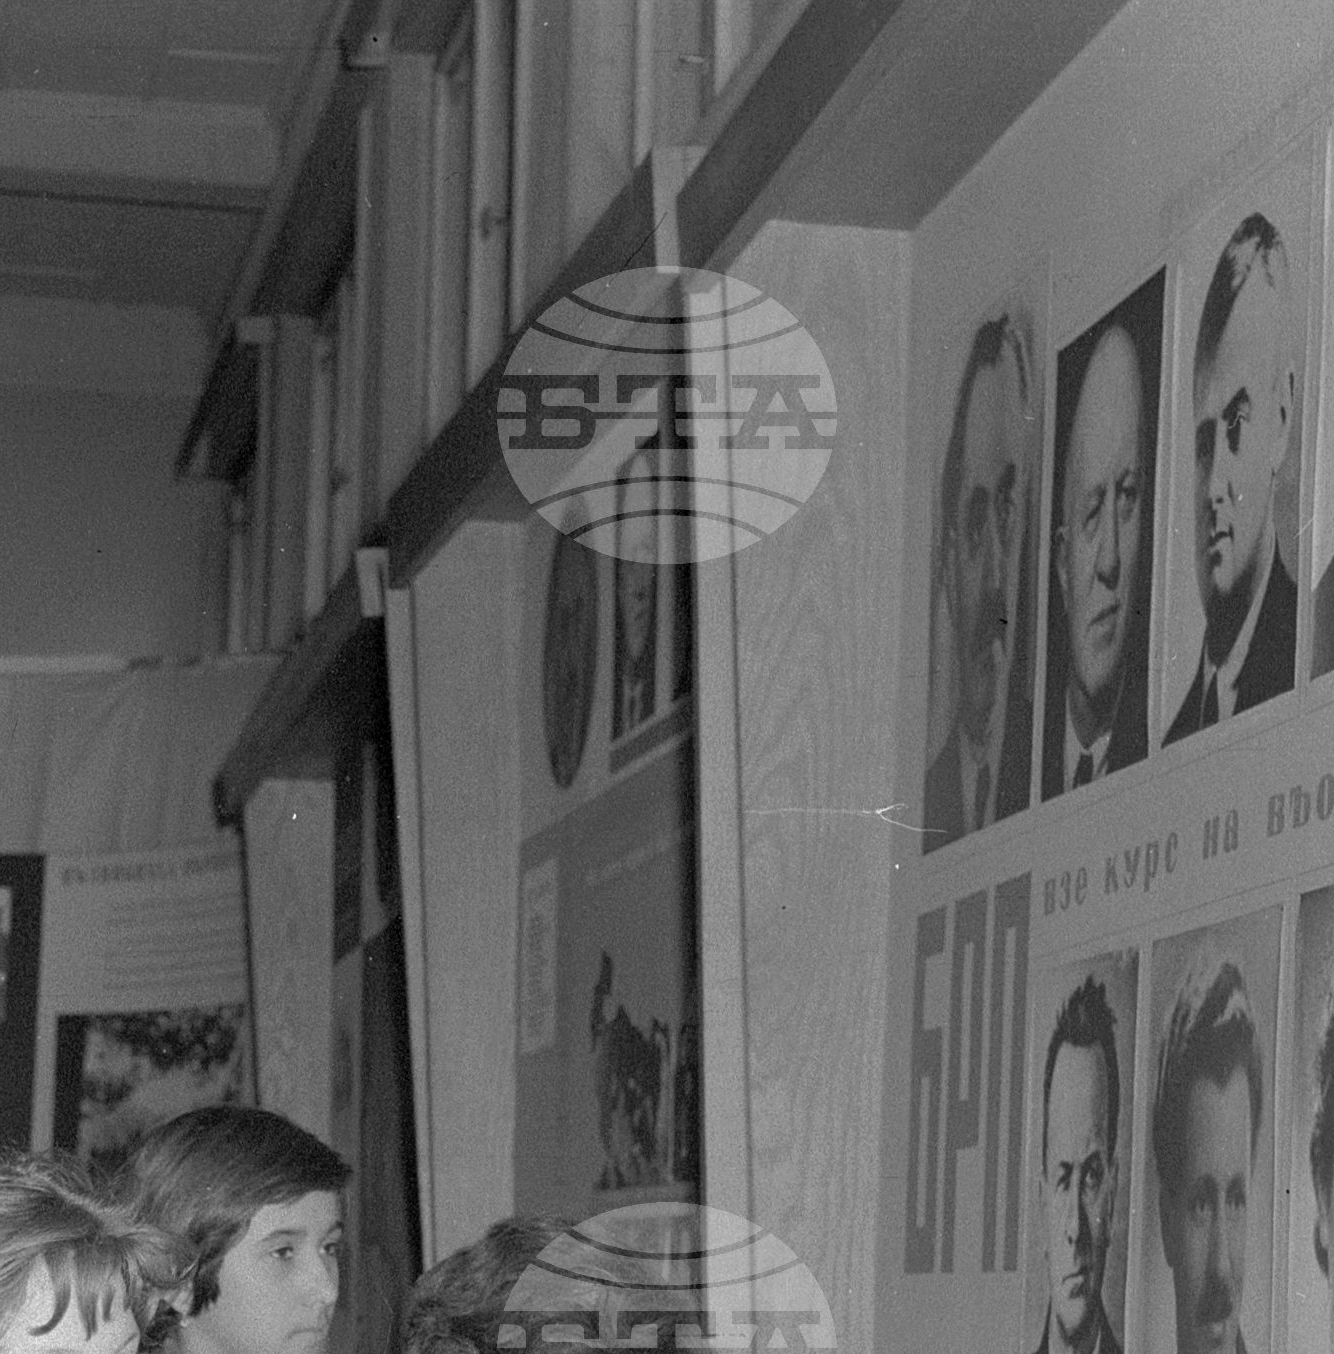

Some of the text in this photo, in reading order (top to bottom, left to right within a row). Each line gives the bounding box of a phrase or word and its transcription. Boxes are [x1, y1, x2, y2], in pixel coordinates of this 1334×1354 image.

[1044, 866, 1088, 916] взе
[1104, 831, 1178, 894] курс
[1202, 809, 1239, 860] на
[904, 871, 1032, 1275] БРП
